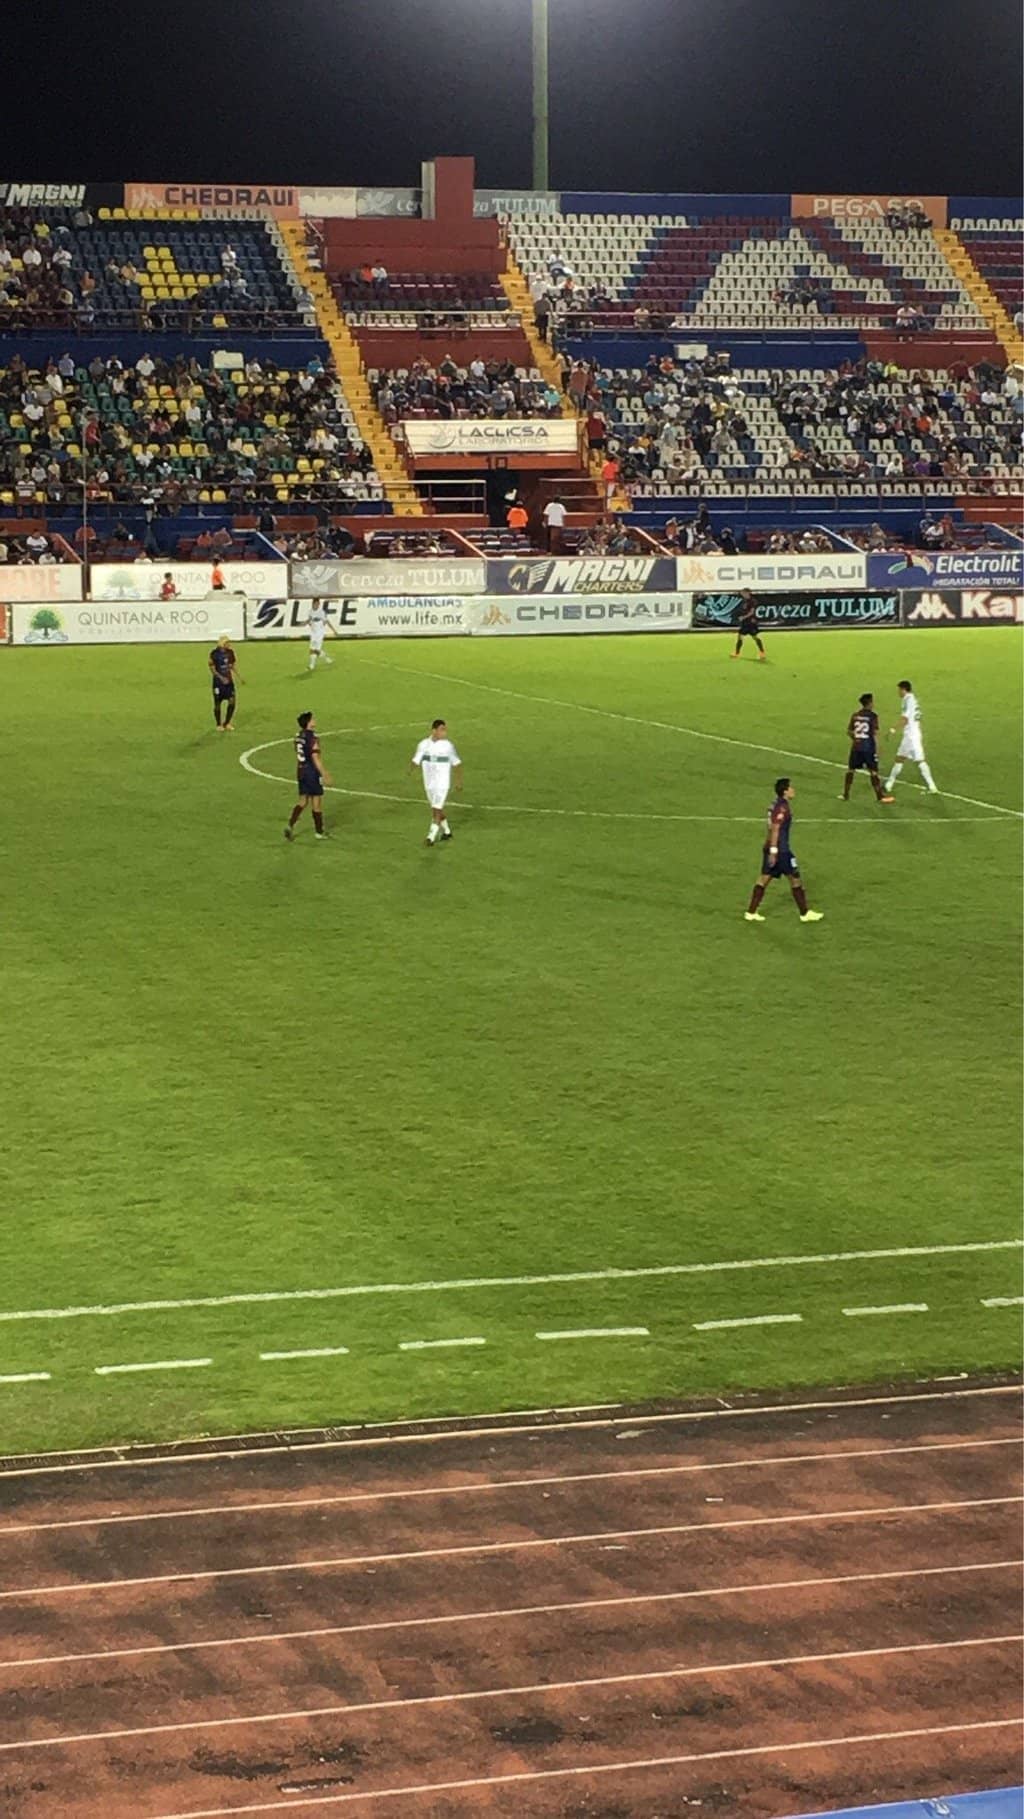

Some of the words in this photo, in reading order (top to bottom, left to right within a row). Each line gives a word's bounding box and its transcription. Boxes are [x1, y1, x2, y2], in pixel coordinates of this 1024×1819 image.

[5, 183, 86, 207] MAGNI
[165, 186, 294, 206] CHEDRAUI
[491, 198, 556, 213] TULUM
[458, 425, 549, 438] LACLICSA
[717, 565, 862, 581] CHEDRAUI
[935, 555, 1022, 574] Electrolit
[339, 571, 404, 587] Cerveza
[407, 568, 485, 586] TULUM
[543, 558, 656, 592] MAGNI
[573, 580, 645, 592] CHARTERS
[516, 602, 684, 621] CHEDRAUI
[755, 603, 811, 618] erveza
[814, 597, 897, 617] TULUM
[78, 610, 165, 626] QUINTANA
[170, 609, 209, 624] ROO
[378, 610, 463, 626] www.life.mx
[853, 721, 870, 739] 22
